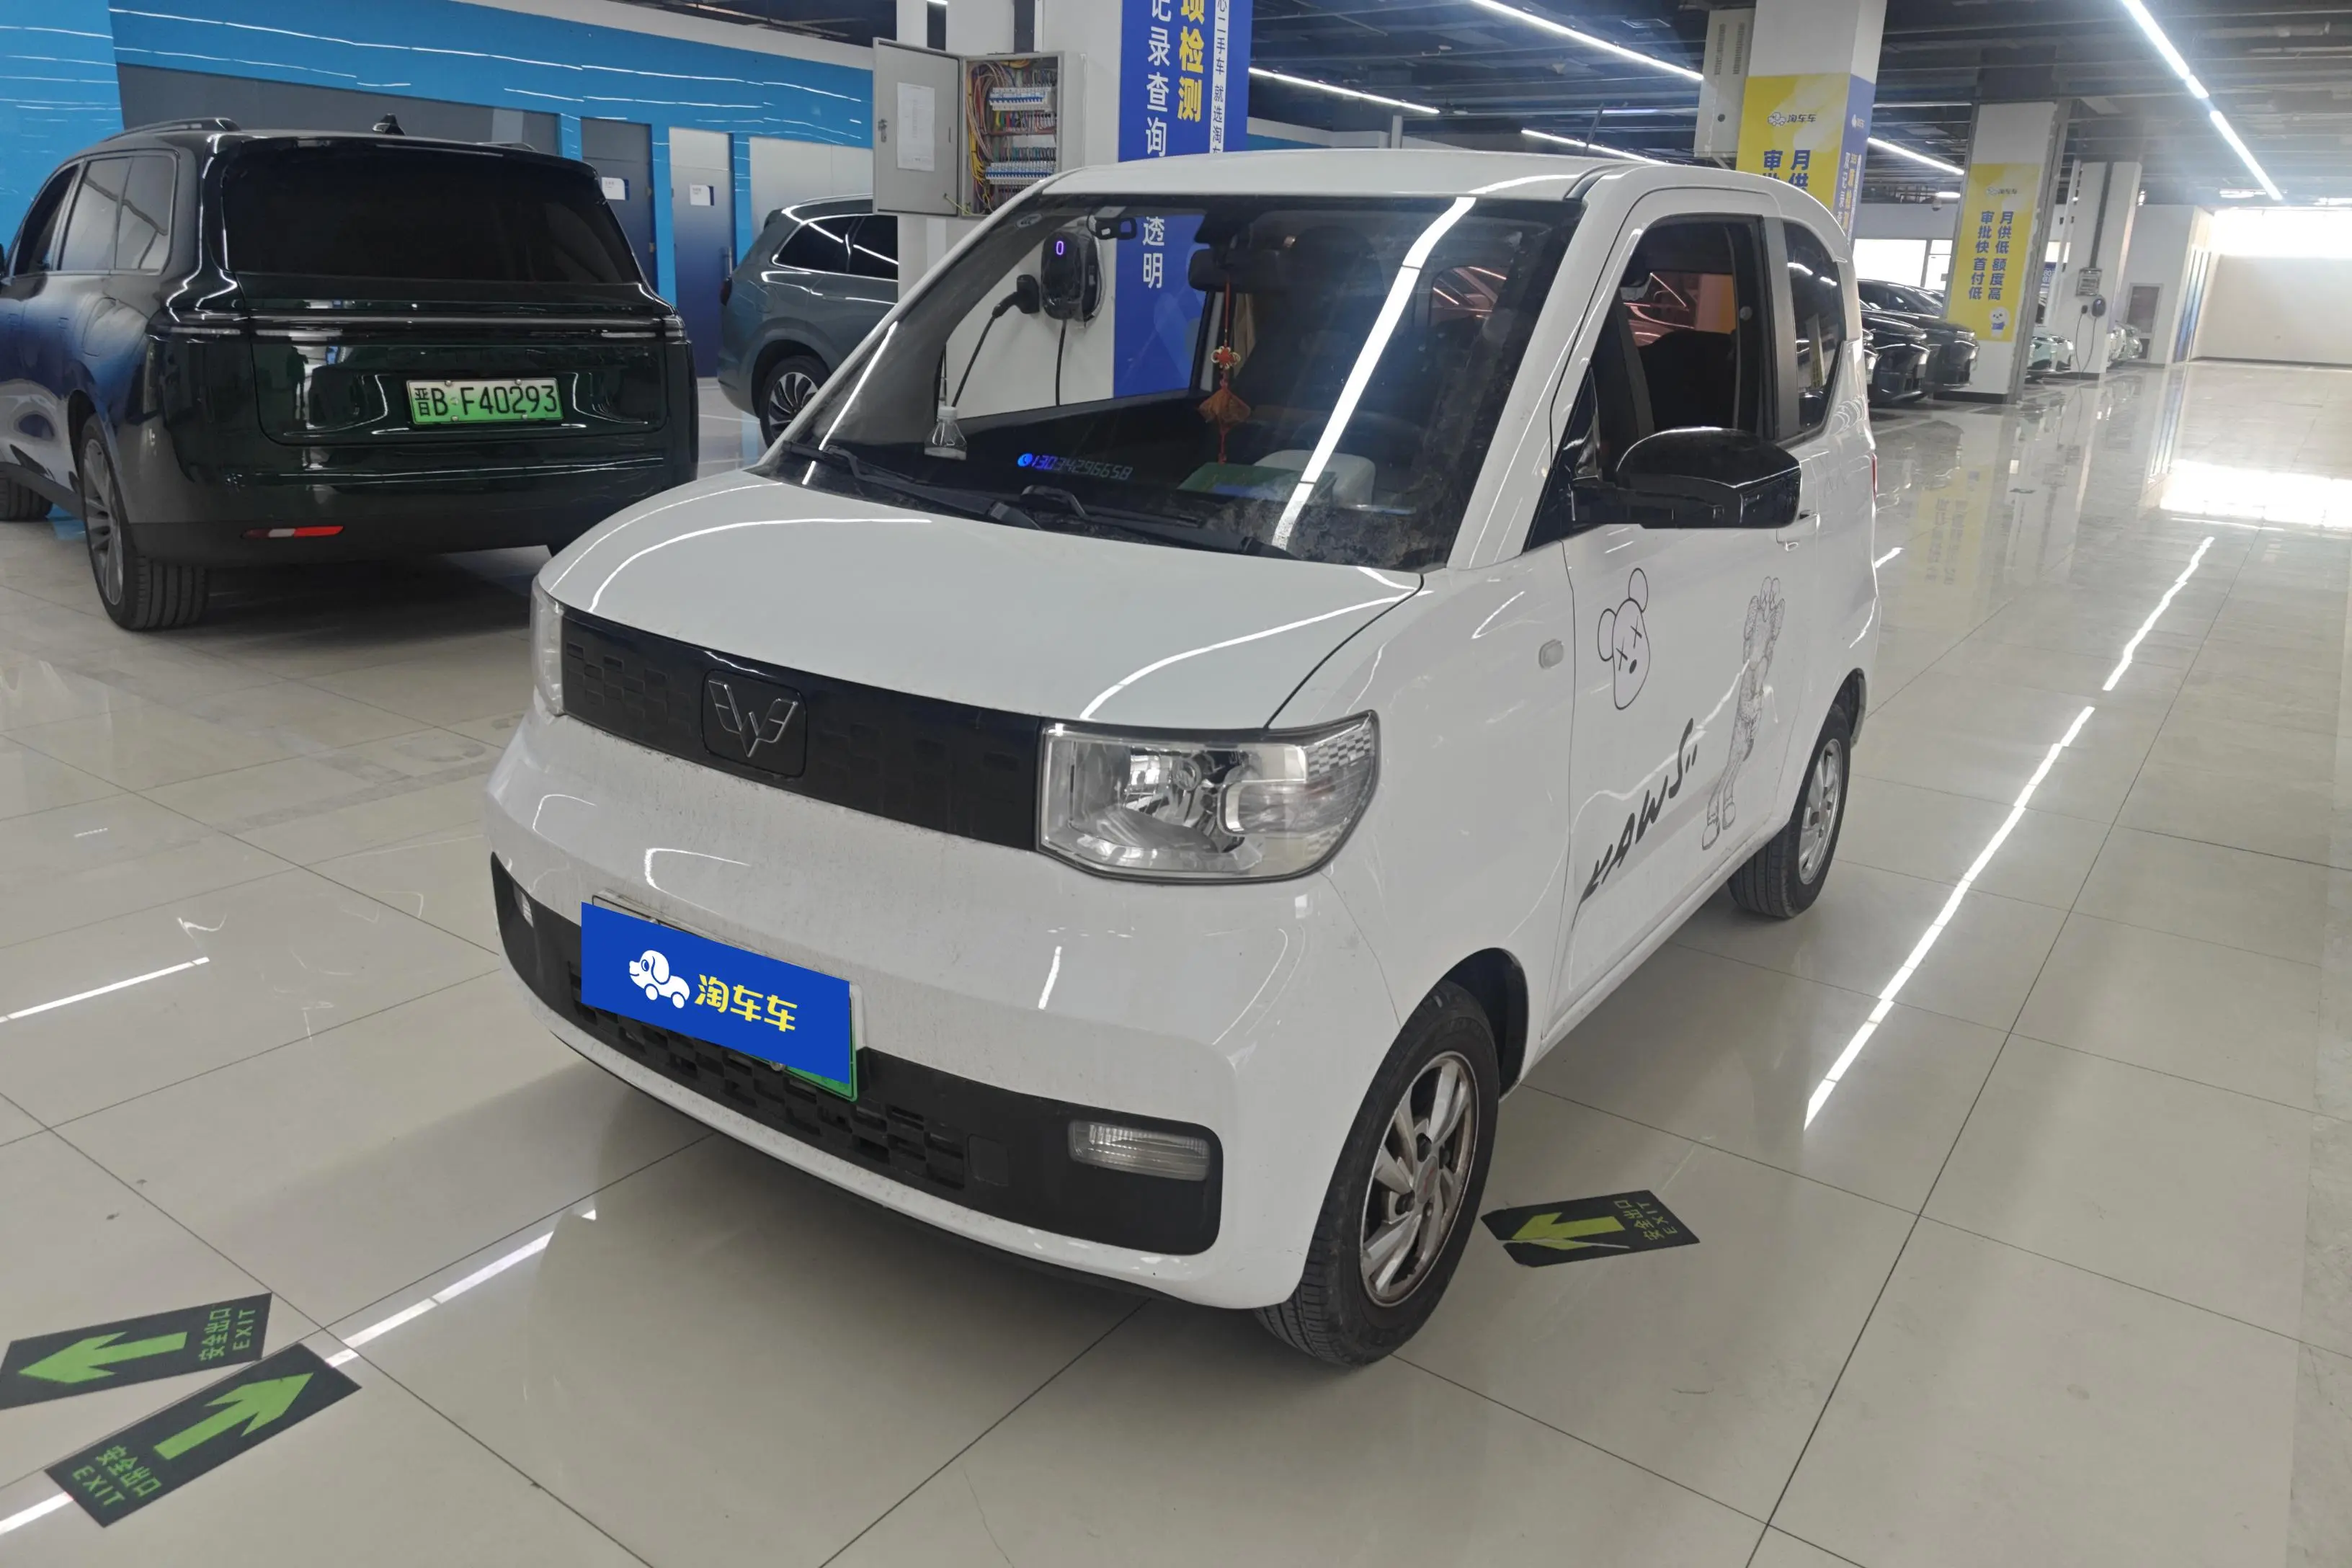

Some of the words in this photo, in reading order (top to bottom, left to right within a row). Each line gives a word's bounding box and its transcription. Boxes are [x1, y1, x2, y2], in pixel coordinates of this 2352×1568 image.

[1613, 1198, 1665, 1242] 安全出口
[1636, 1201, 1678, 1235] EXIT
[198, 1306, 233, 1361] 安全出口
[232, 1308, 257, 1352] EXIT
[72, 1464, 125, 1507] EXIT
[94, 1445, 162, 1498] 安全出口
